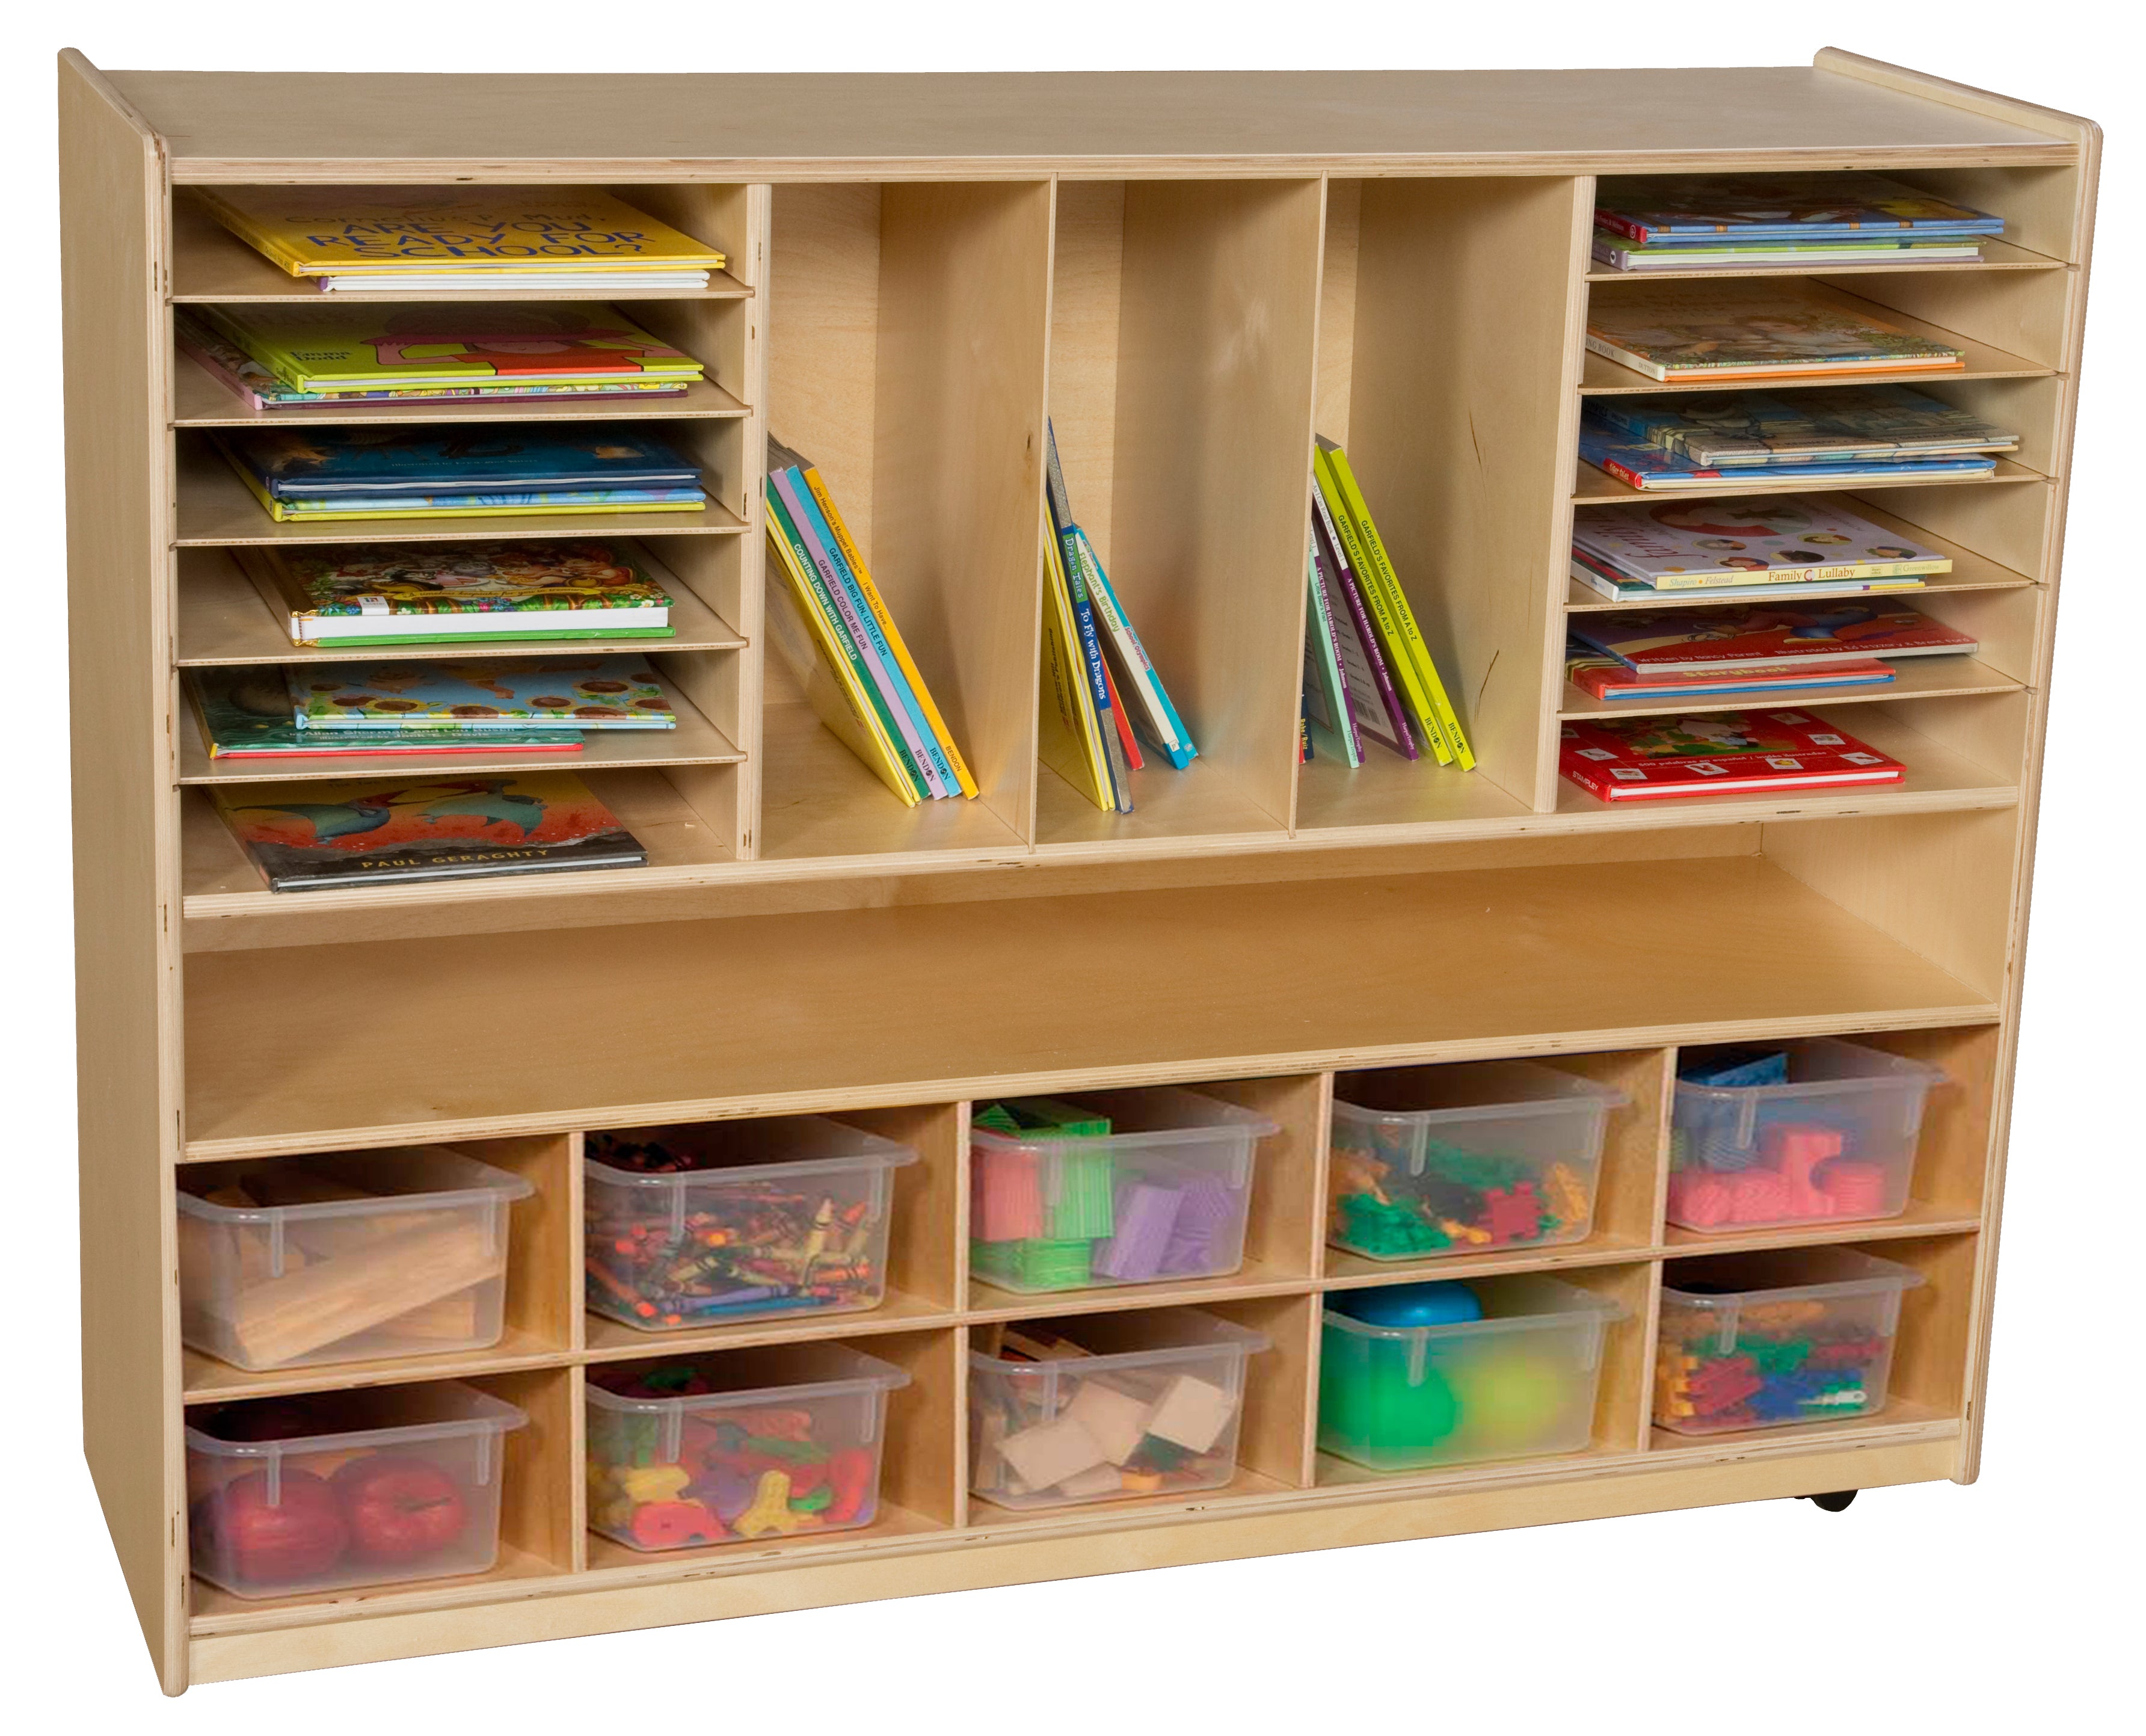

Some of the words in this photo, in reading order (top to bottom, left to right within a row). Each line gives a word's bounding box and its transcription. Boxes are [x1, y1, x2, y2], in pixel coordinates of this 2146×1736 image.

[343, 223, 453, 234] ARE
[469, 221, 592, 233] YOU
[307, 233, 506, 247] READY
[540, 232, 656, 244] FOR
[354, 244, 648, 257] SCHOOL?
[1598, 343, 1616, 358] BOOK
[1638, 362, 1656, 374] DUTTON
[814, 485, 823, 497] Jim
[822, 496, 837, 526] Henson's
[835, 525, 849, 549] Muppet
[864, 585, 876, 603] Want
[872, 602, 880, 610] To
[1326, 520, 1335, 534] Book
[1334, 543, 1343, 557] Level
[1065, 537, 1077, 571] Dragon
[1072, 573, 1084, 599] Tales
[1768, 570, 1803, 582] Family
[1818, 567, 1856, 579] Lullaby
[1079, 552, 1101, 596] Elephant's
[1099, 596, 1120, 632] Birthday
[1670, 578, 1697, 587] Shapiro
[1705, 576, 1734, 585] Felstead
[1348, 583, 1361, 606] PICTURE
[1080, 608, 1090, 623] To
[1318, 570, 1328, 599] PICTURE
[1327, 612, 1338, 642] HAROLD'S
[1333, 642, 1342, 662] ROOM
[1359, 606, 1367, 620] FOR
[1084, 622, 1094, 638] Fly
[1338, 515, 1360, 557] GARFIELD'S
[1356, 556, 1376, 596] FAVORITES
[1373, 594, 1386, 617] FROM
[1384, 623, 1391, 631] to
[1424, 717, 1443, 749] BENDON
[1361, 520, 1383, 562] GARFIELD'S
[1379, 562, 1400, 601] FAVORITES
[1397, 600, 1409, 623] FROM
[1407, 627, 1413, 636] to
[1448, 722, 1466, 754] BENDON
[1362, 619, 1378, 649] HAROLD'S
[1087, 639, 1098, 660] with
[1374, 648, 1385, 666] ROOM
[1680, 654, 1693, 662] by
[794, 543, 816, 583] COUNTING
[814, 580, 829, 606] DOWN
[825, 605, 838, 624] WITH
[835, 624, 857, 661] GARFIELD
[900, 749, 920, 783] BENDON
[818, 559, 840, 596] GARFIELD
[837, 596, 853, 623] COLOR
[850, 621, 860, 633] ME
[856, 633, 868, 650] FUN
[915, 749, 936, 782] BENDON
[829, 547, 850, 585] GARFIELD
[847, 583, 858, 599] BIG
[863, 615, 880, 641] LITTLE
[876, 639, 888, 657] FUN
[930, 747, 950, 781] BENDON
[1682, 666, 1790, 678] Storybook
[1092, 660, 1106, 700] Dragons
[945, 745, 961, 772] BENDON
[1572, 771, 1599, 792] STAMPLEY
[361, 859, 421, 868] PAUL
[431, 849, 548, 864] GERAGHTY
